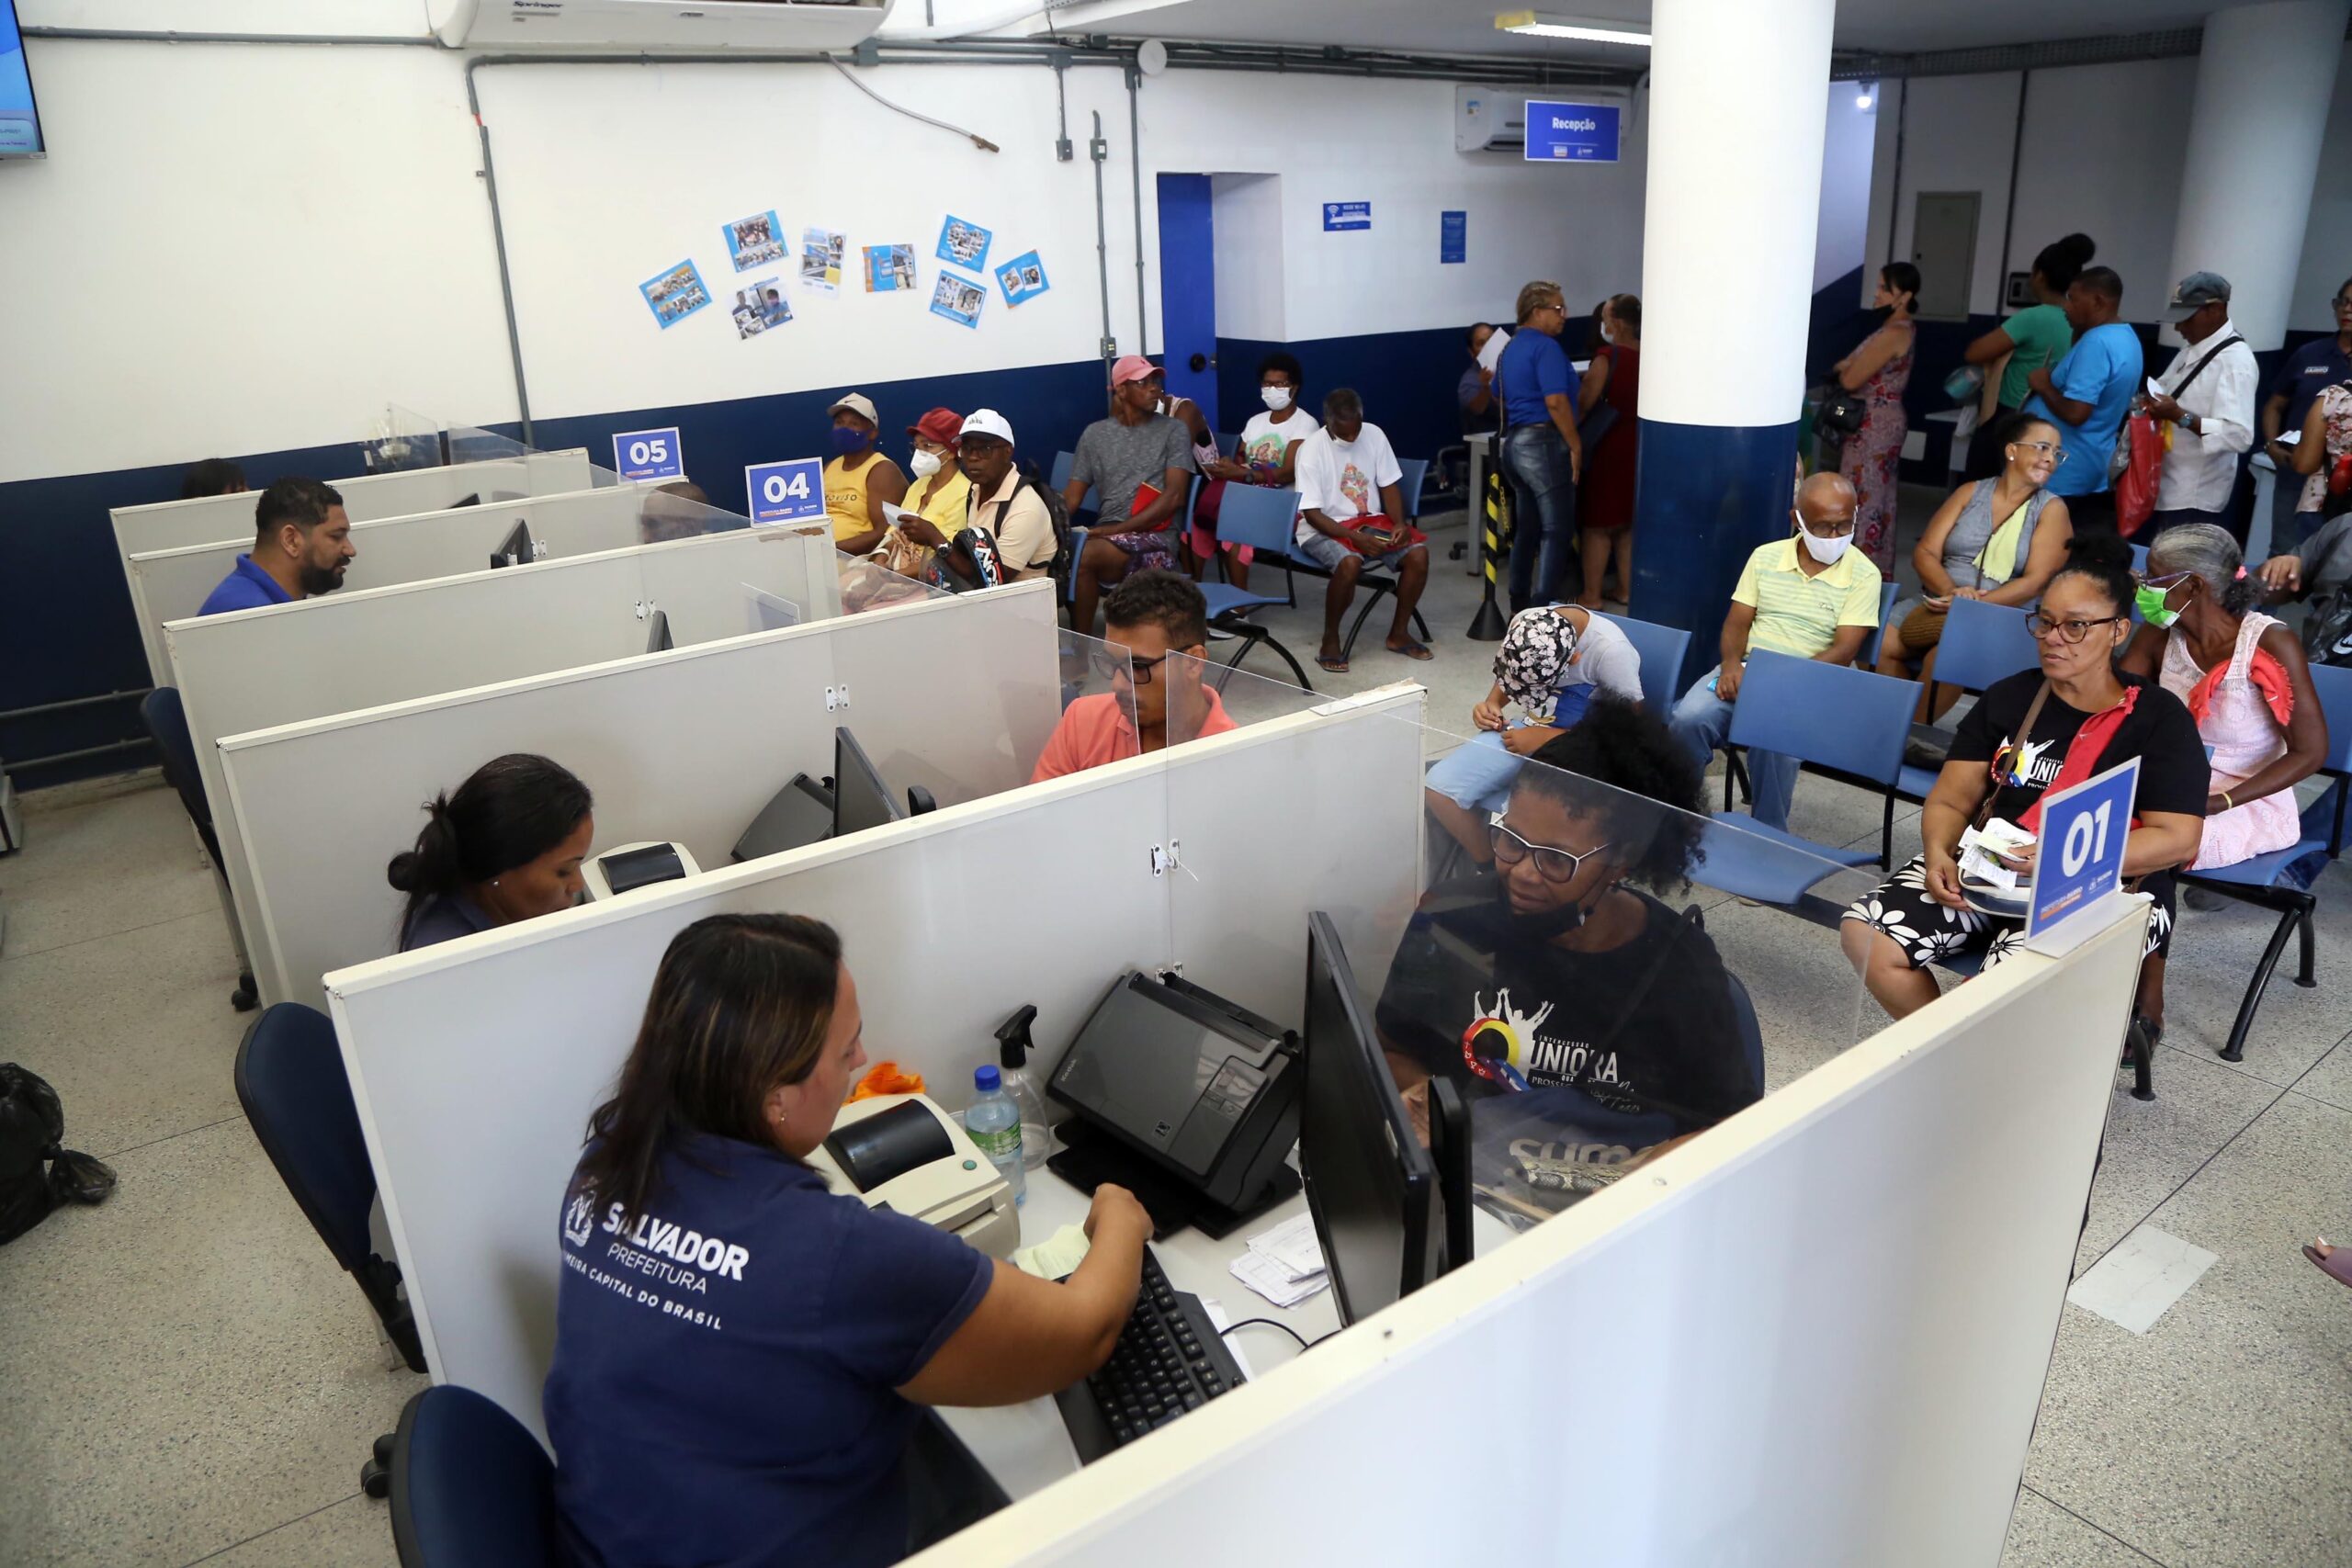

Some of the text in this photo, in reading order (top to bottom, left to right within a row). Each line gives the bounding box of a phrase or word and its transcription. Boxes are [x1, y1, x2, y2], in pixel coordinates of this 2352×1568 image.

[1552, 117, 1596, 131] Recepção
[629, 439, 668, 466] 05
[763, 472, 810, 503] 04
[2062, 798, 2112, 877] 01
[607, 1243, 707, 1295] PREFEITURA
[589, 1268, 633, 1298] CAPITAL
[637, 1290, 659, 1308] DO
[662, 1300, 722, 1330] BRASIL
